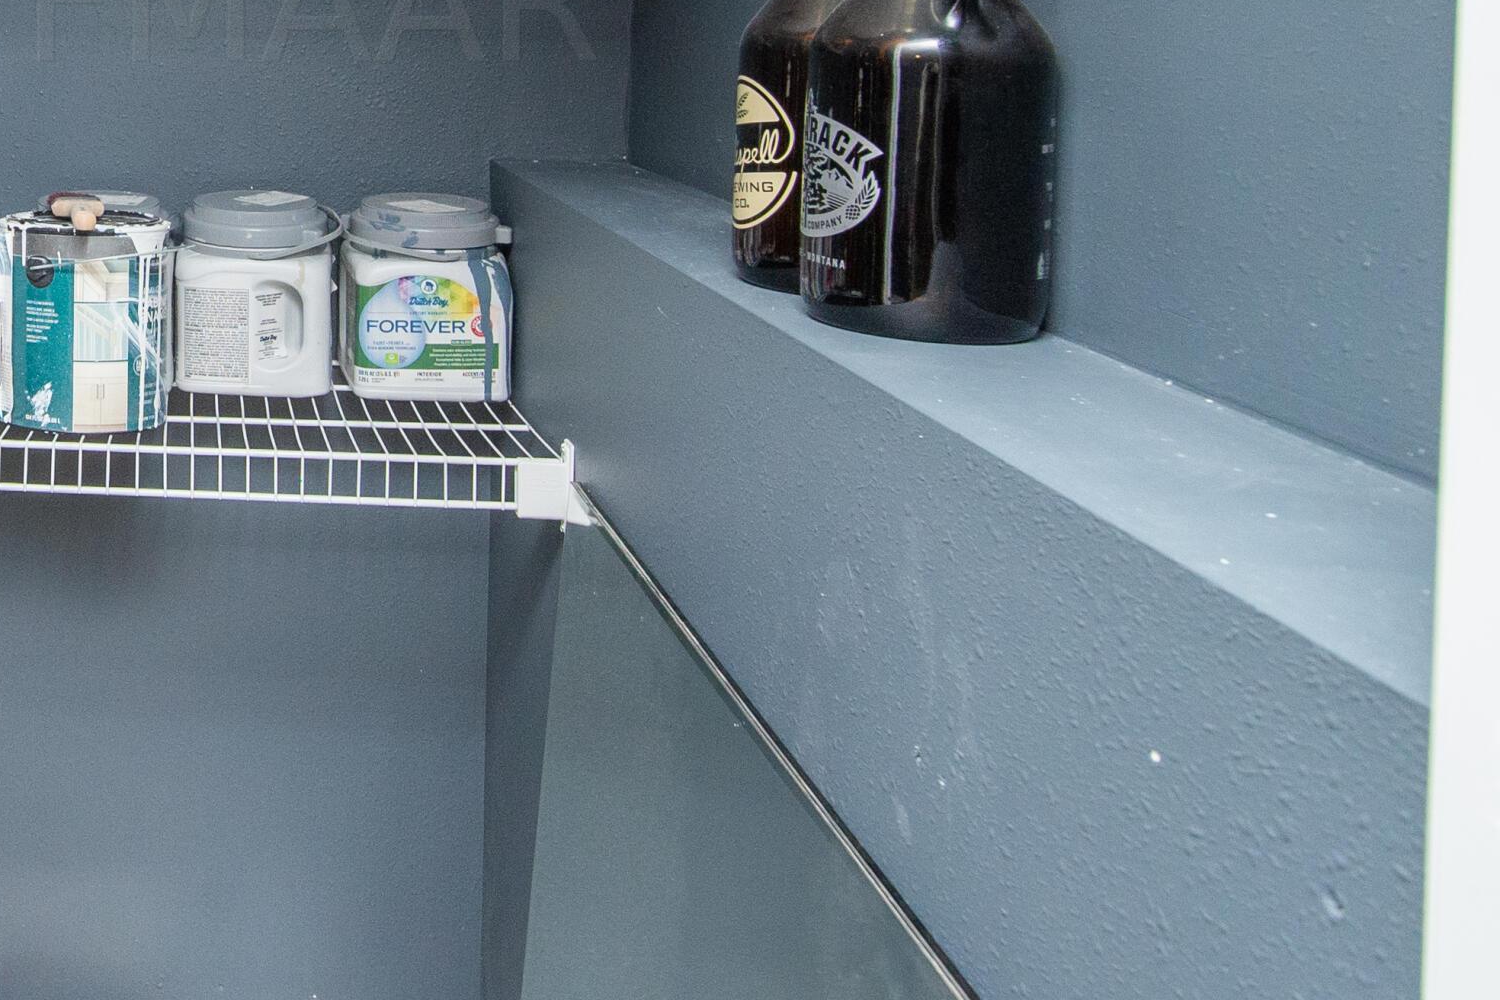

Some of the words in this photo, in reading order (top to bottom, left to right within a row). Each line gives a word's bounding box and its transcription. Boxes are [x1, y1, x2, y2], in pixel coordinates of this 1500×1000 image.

[807, 215, 842, 230] COMPANY
[805, 250, 846, 270] MONTANA
[409, 296, 432, 306] Dutch
[432, 296, 449, 308] Boy
[366, 319, 466, 334] FOREVER
